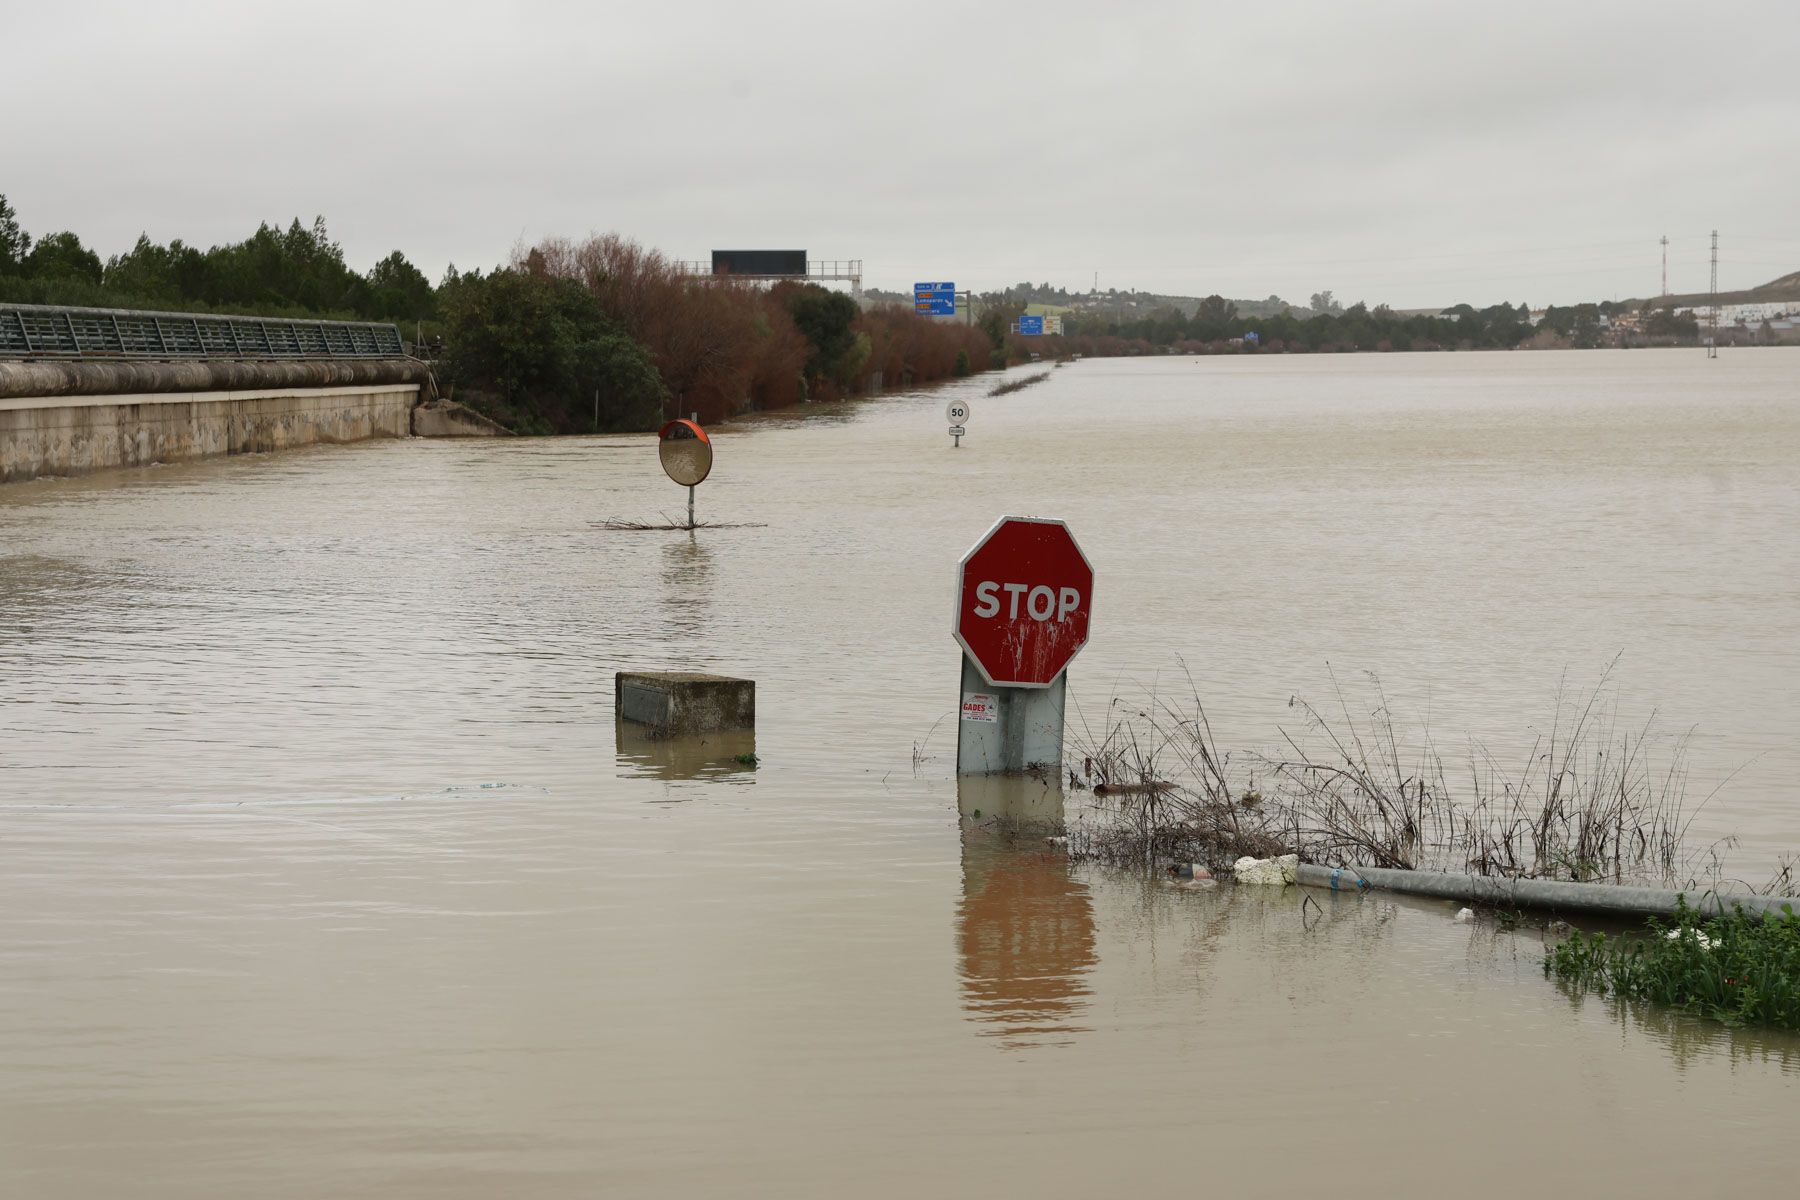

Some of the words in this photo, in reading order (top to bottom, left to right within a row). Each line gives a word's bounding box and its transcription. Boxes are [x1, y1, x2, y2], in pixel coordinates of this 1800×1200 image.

[952, 408, 964, 417] 50
[974, 581, 1080, 622] STOP
[963, 703, 986, 711] GADES
